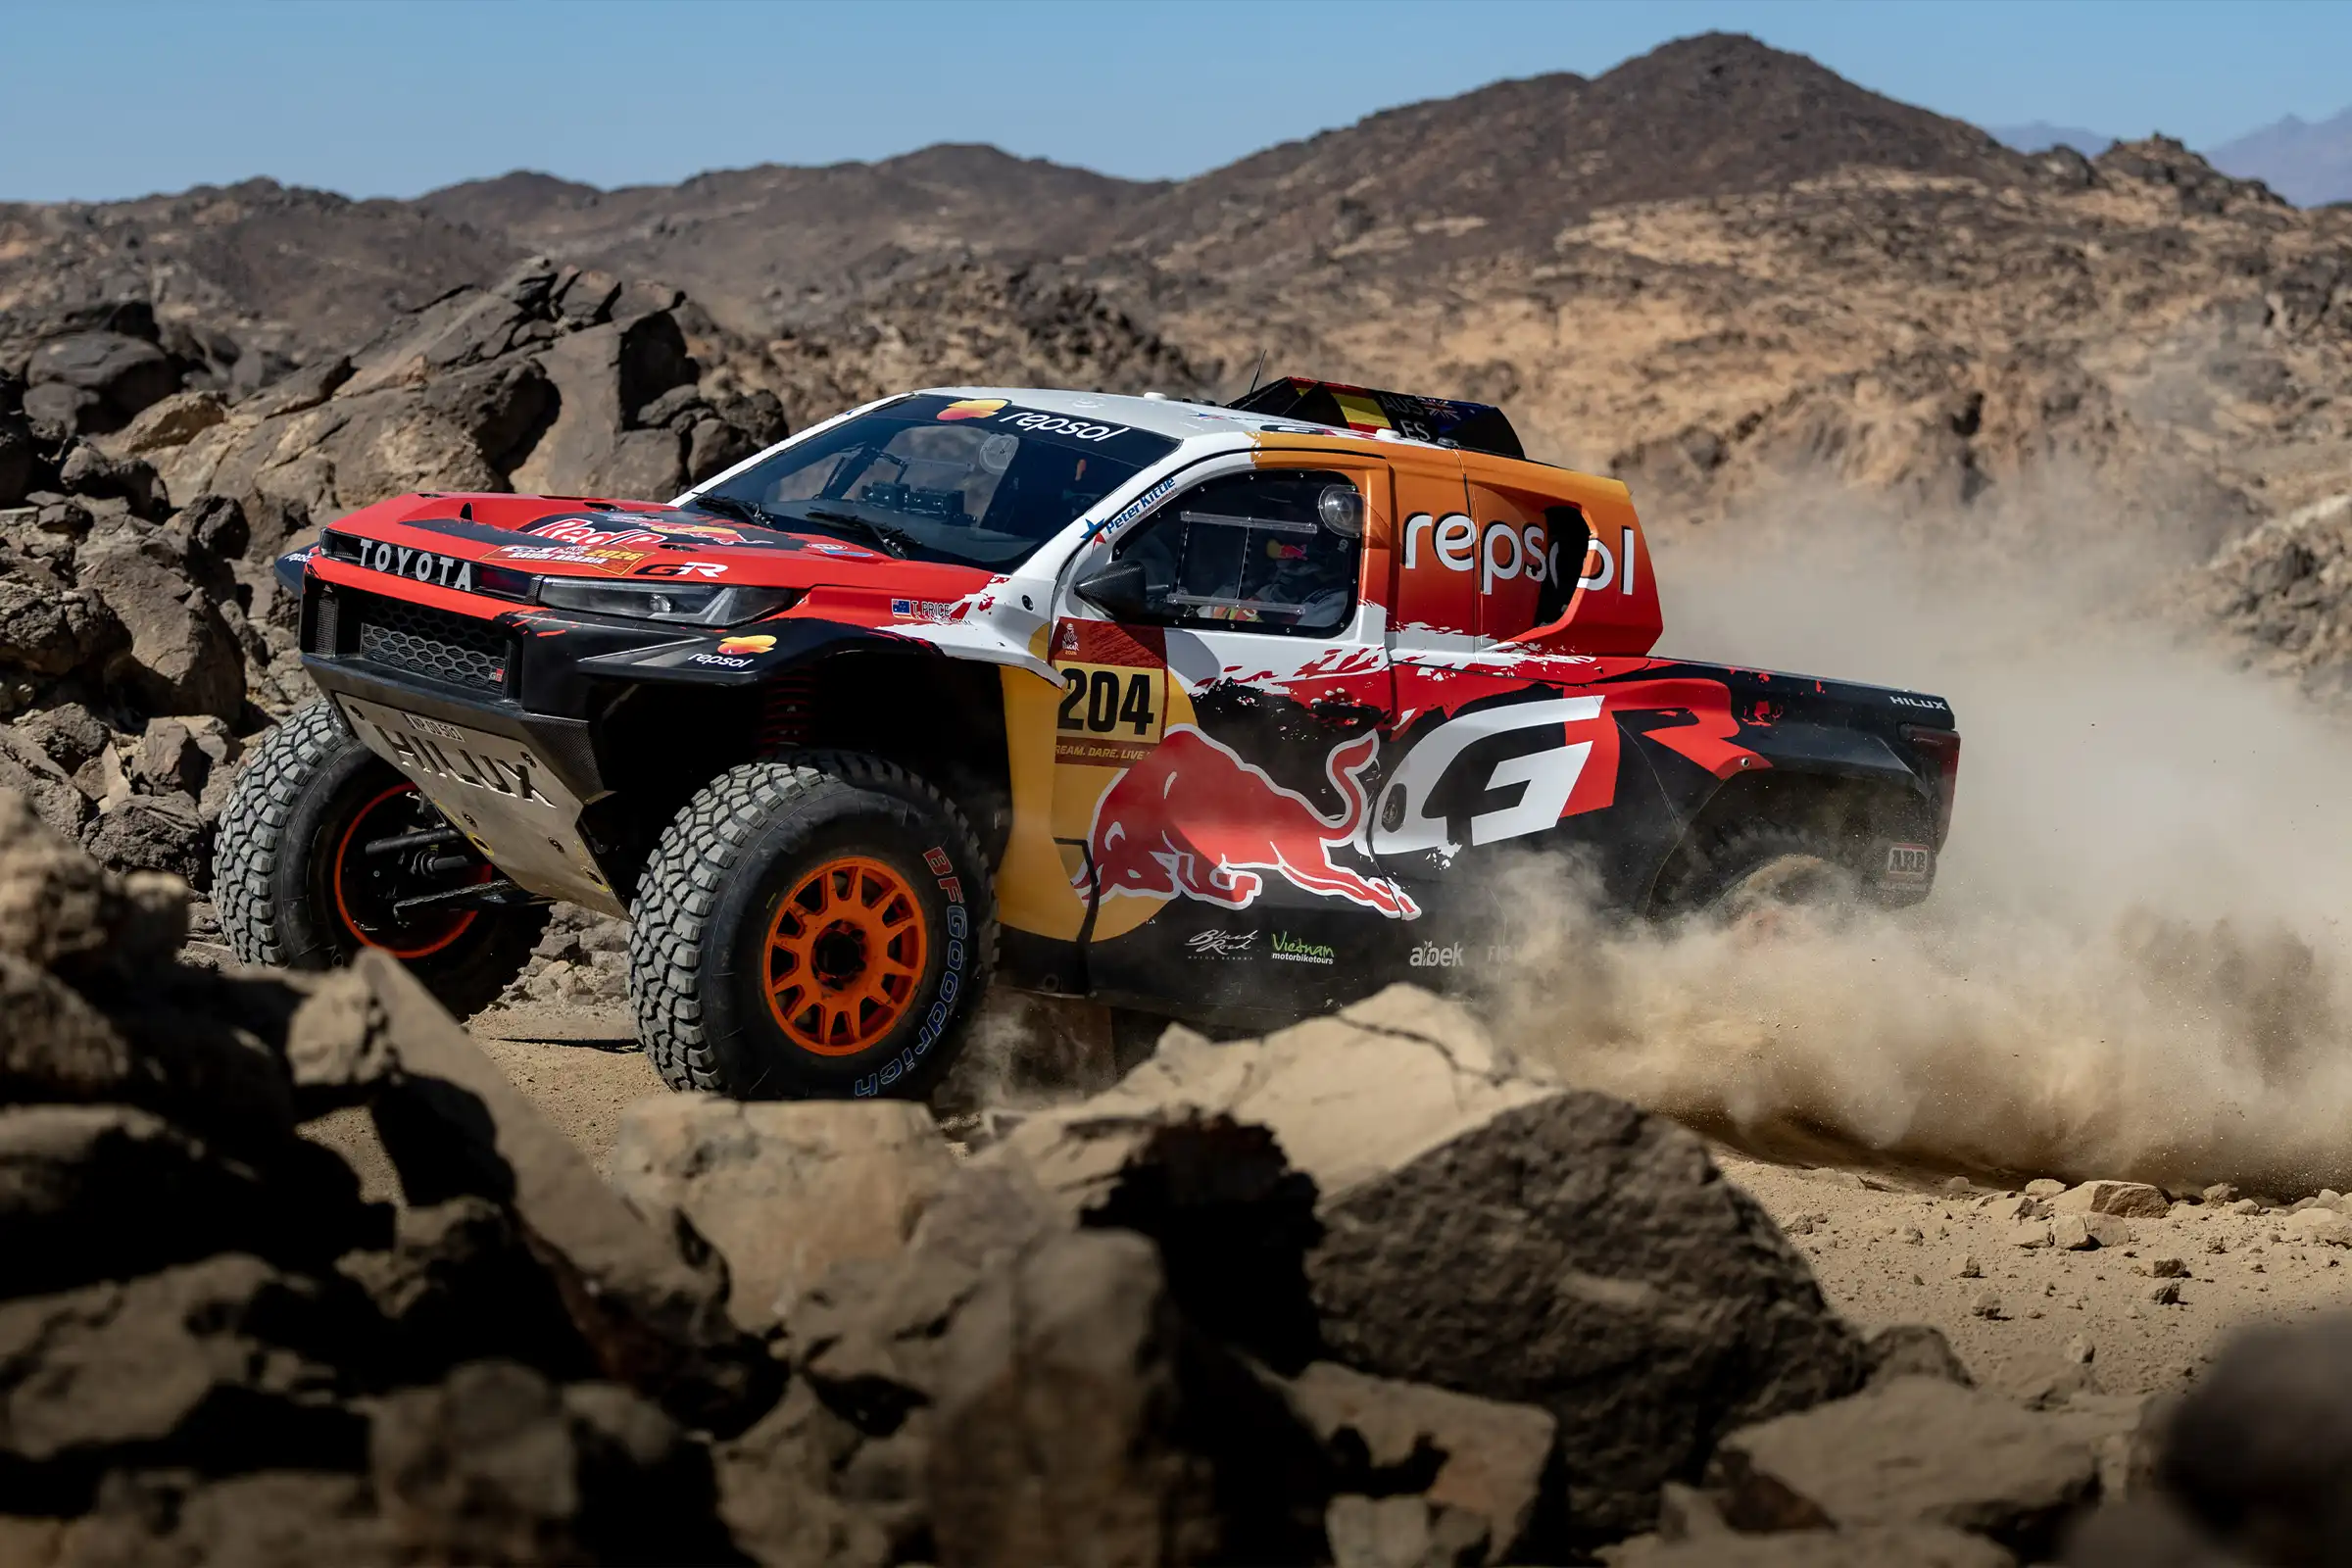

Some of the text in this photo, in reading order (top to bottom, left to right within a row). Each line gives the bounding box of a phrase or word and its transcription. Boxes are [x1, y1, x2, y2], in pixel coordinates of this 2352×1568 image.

[1380, 395, 1424, 416] AUS
[999, 412, 1131, 442] repsol
[1399, 418, 1431, 441] ES
[1105, 503, 1141, 534] Peter
[1140, 476, 1176, 508] Kittle
[550, 553, 609, 564] ARABIA
[585, 549, 645, 561] 2026
[1405, 514, 1635, 595] repsol
[360, 538, 471, 592] TOYOTA
[634, 562, 728, 578] GR
[911, 601, 950, 616] T. PRICE
[688, 654, 755, 668] repsol
[1057, 667, 1154, 736] 204
[1889, 695, 1947, 710] HILUX
[1055, 745, 1086, 757] REAM.
[1088, 747, 1119, 759] DARE.
[1121, 750, 1145, 760] LIVE
[373, 724, 557, 808] HILUX
[1184, 929, 1259, 947] Black
[1195, 939, 1252, 956] Rock
[1272, 930, 1336, 958] Vietnam
[1272, 952, 1334, 965] motorbiketours
[855, 847, 968, 1098] BFGoodrich
